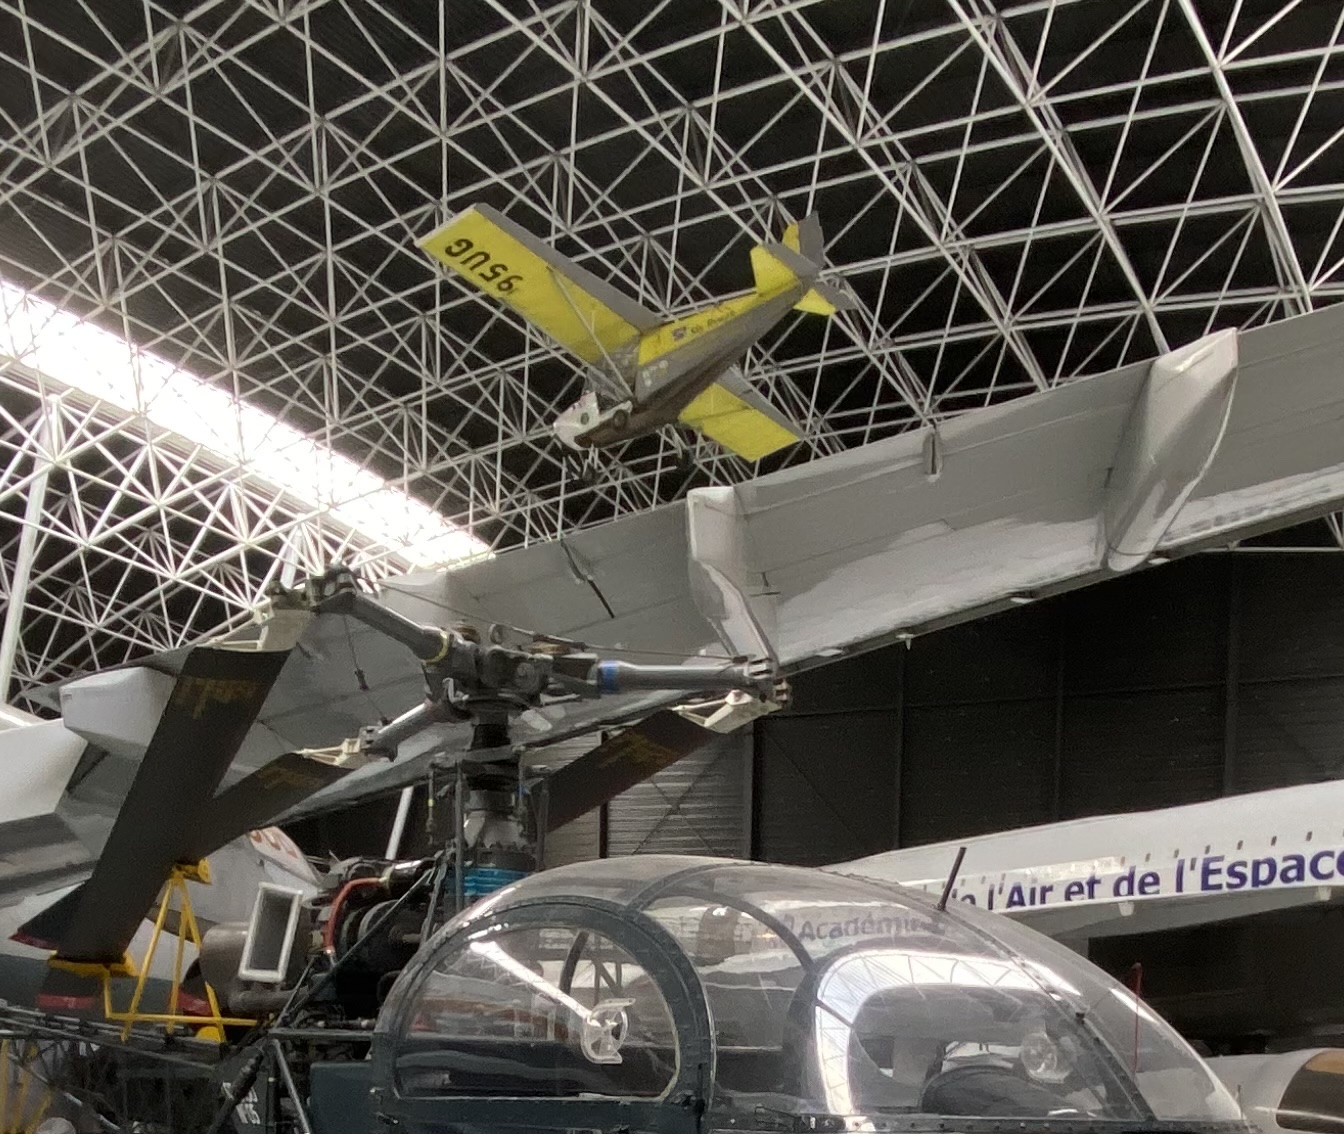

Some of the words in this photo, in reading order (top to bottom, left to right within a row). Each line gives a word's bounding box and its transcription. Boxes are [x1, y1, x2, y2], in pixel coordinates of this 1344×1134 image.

[444, 238, 524, 292] 95UG
[1064, 873, 1102, 902] et
[1112, 865, 1160, 897] de
